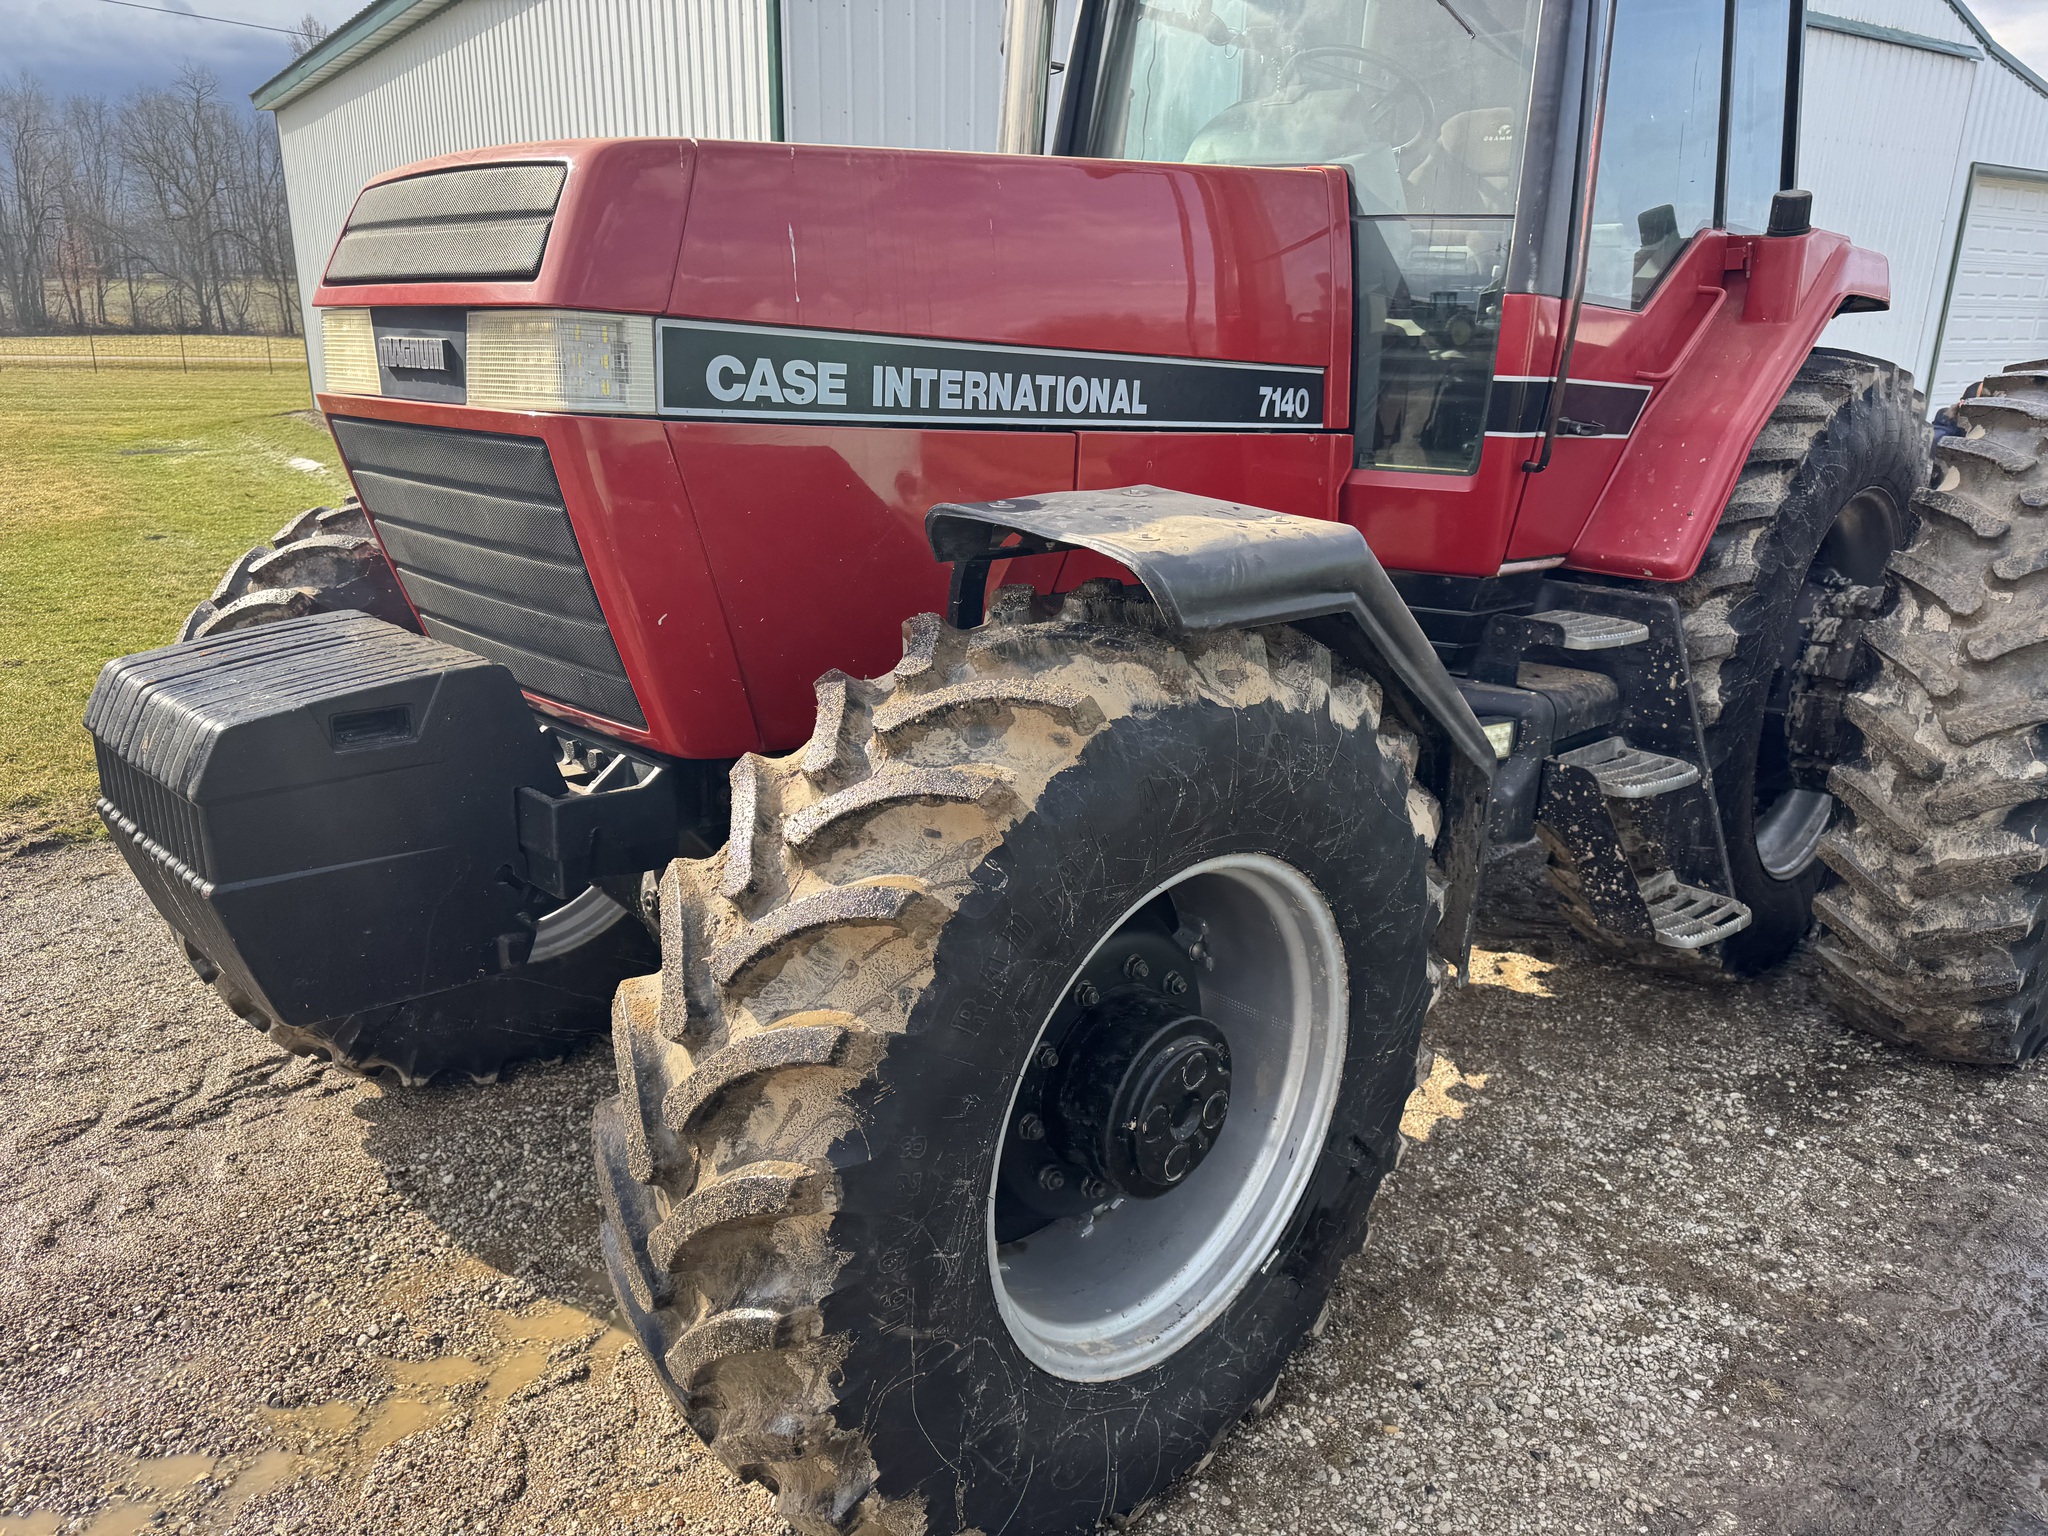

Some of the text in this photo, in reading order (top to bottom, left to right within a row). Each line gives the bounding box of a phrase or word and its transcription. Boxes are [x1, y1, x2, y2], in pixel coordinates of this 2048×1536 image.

[379, 336, 446, 370] MAGNUM
[705, 354, 1149, 415] CASE INTERNATIONAL
[1258, 386, 1310, 418] 7140
